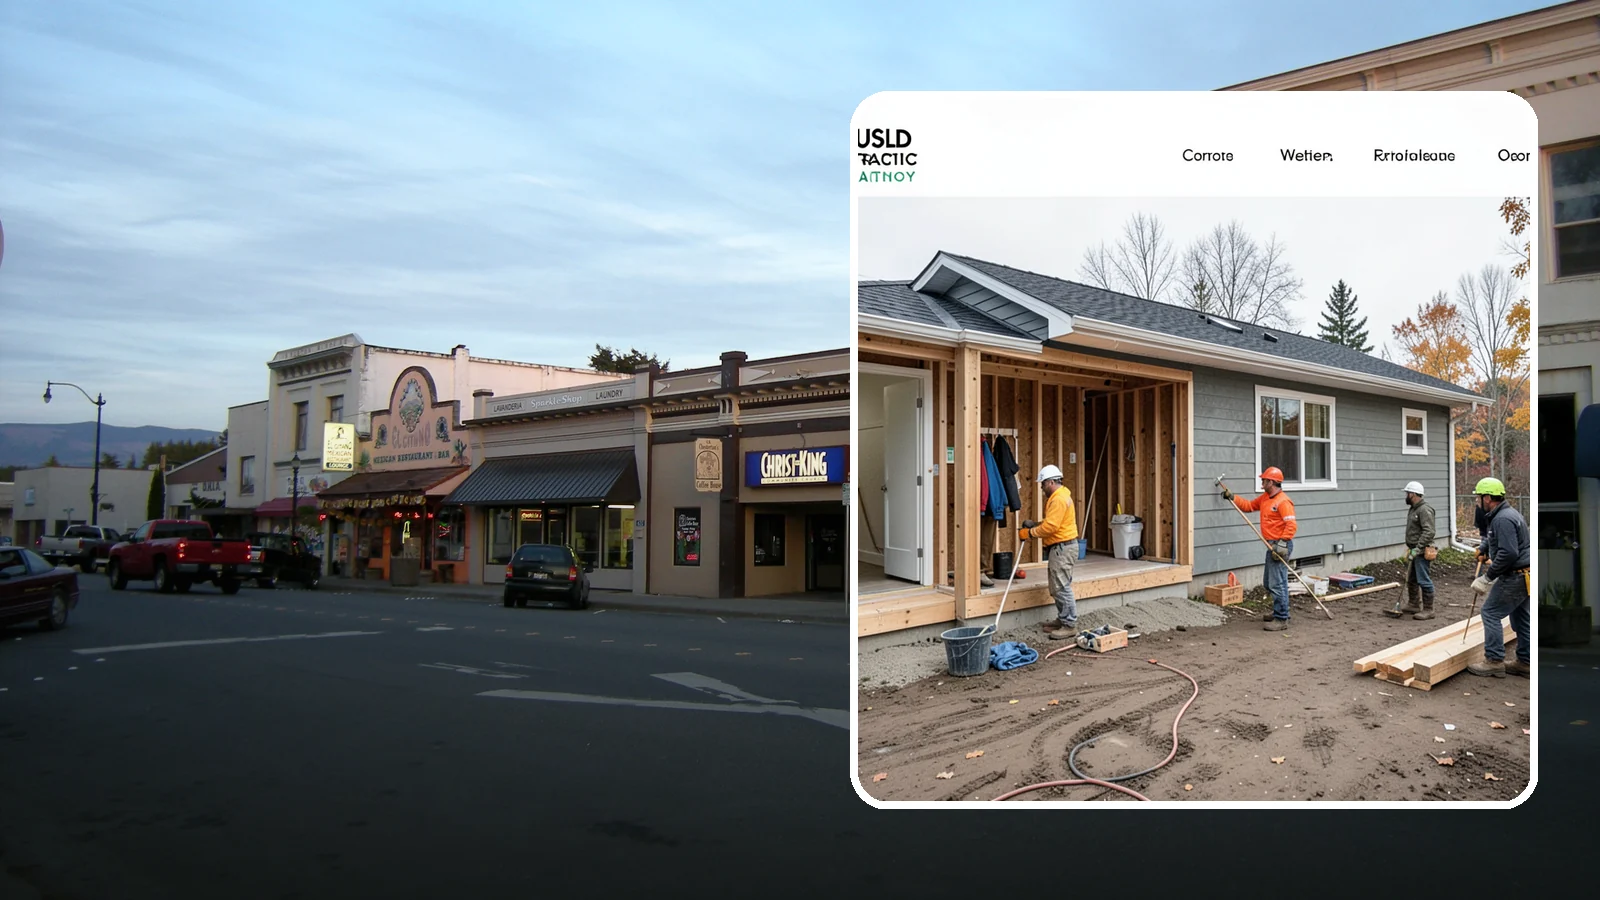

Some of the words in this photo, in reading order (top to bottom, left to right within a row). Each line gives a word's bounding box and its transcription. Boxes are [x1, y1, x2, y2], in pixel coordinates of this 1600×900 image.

[594, 388, 624, 400] LAUNDRY
[493, 402, 523, 413] LAVANDERIA
[530, 397, 561, 410] Sparkle
[561, 394, 584, 406] Shop
[397, 451, 433, 463] RESTAURANT
[438, 450, 450, 459] BAR
[799, 450, 828, 477] KING
